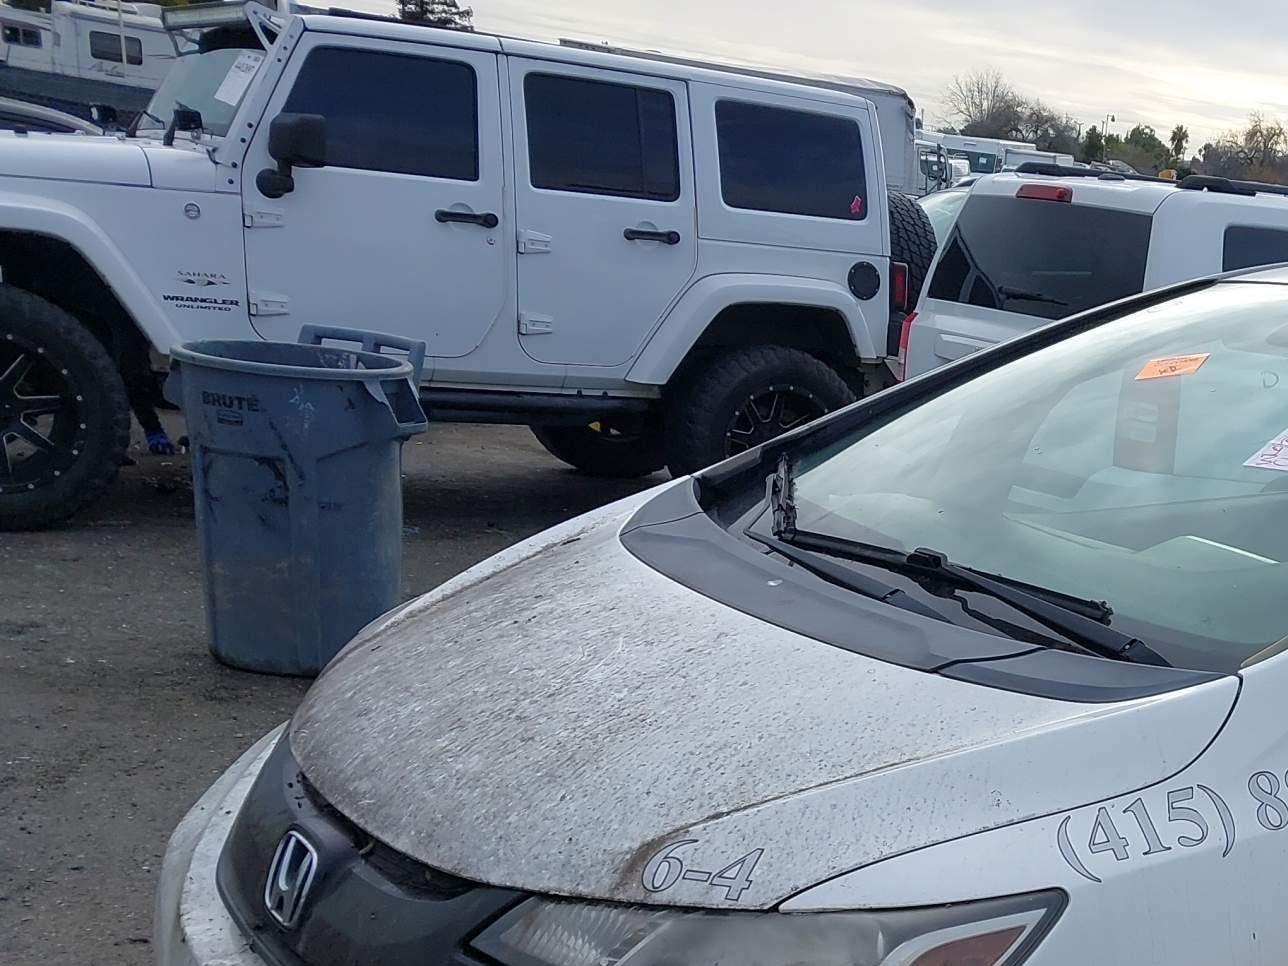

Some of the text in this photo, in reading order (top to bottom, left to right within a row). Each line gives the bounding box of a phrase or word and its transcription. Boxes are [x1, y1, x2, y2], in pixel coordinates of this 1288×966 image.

[177, 270, 227, 280] SAHARA
[162, 294, 240, 307] WRANGLER
[175, 303, 232, 312] UNLIMITED
[202, 391, 261, 412] BRUTE
[1057, 783, 1236, 883] (415)
[641, 838, 765, 902] 6-4
